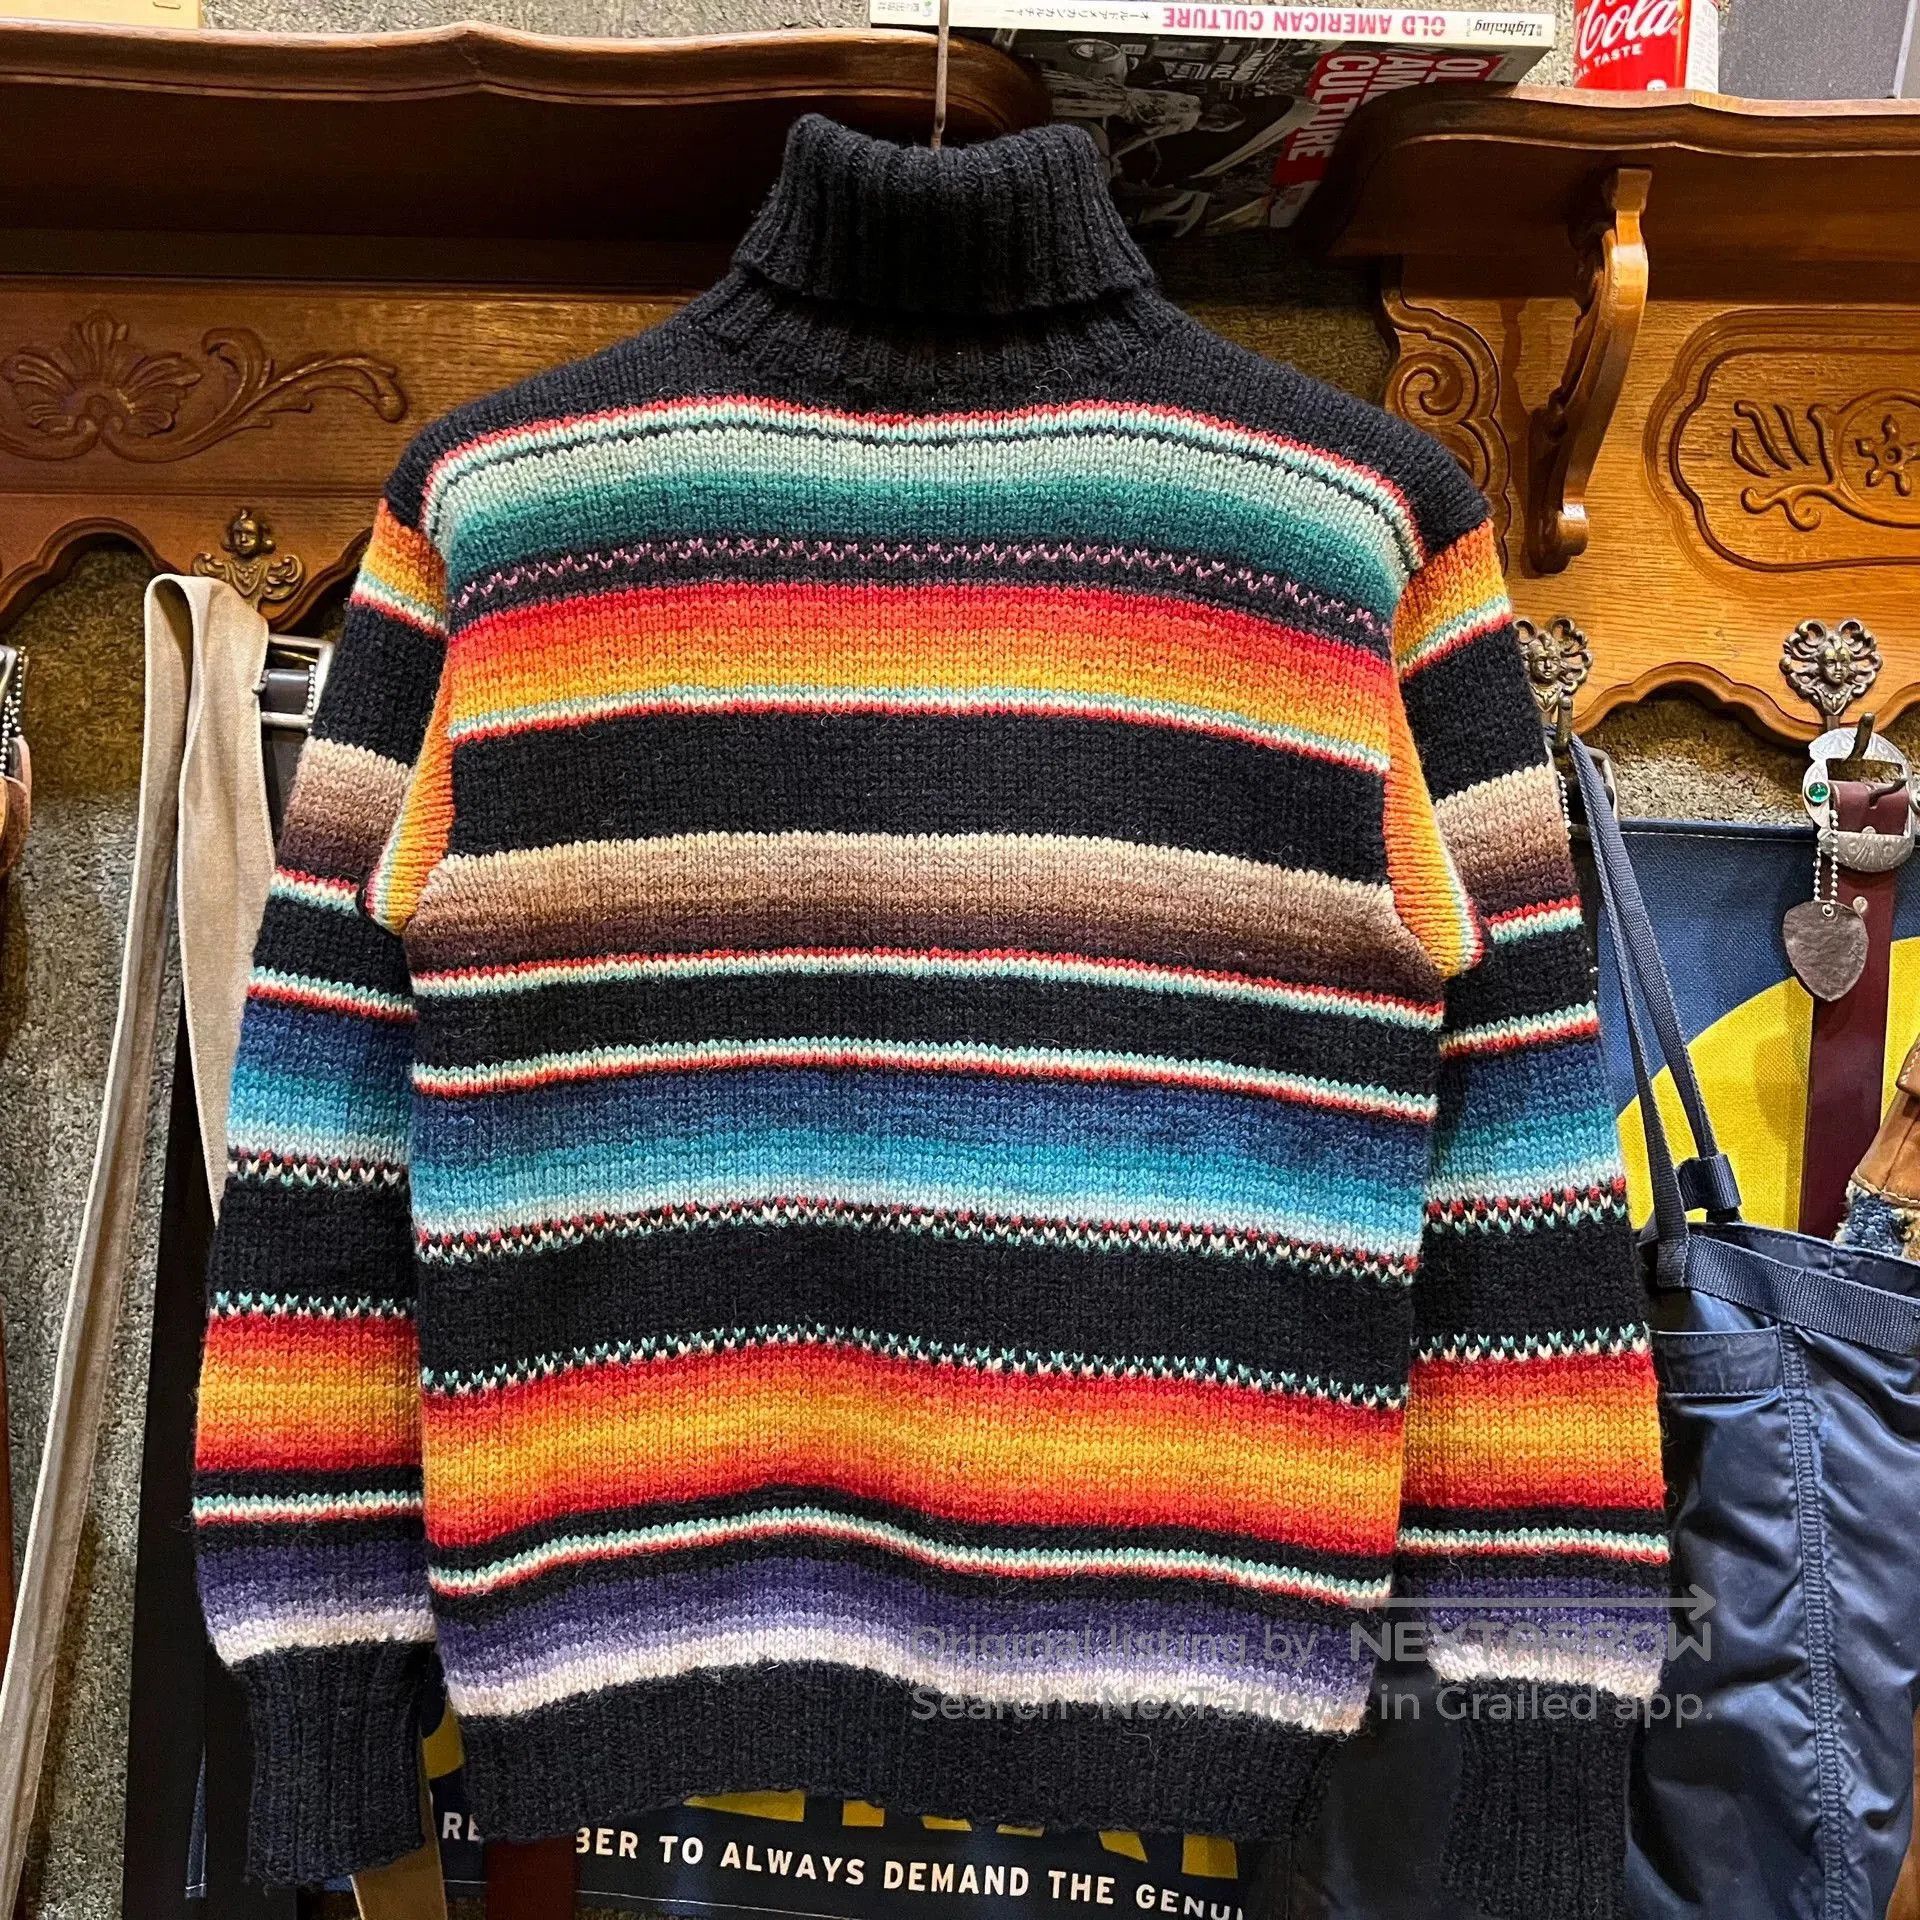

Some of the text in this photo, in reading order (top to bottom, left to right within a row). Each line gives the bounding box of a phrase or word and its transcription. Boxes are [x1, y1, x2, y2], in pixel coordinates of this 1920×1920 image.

[1162, 7, 1264, 31] CULTURE
[1273, 11, 1392, 34] AMERICAN
[1401, 16, 1446, 36] OLD
[1473, 20, 1536, 37] Lightning
[1593, 43, 1642, 67] TASTE
[1423, 57, 1490, 84] OL
[1287, 55, 1380, 162] CULTURE
[658, 1835, 704, 1865] TO
[720, 1842, 865, 1886] ALWAYS
[883, 1860, 1029, 1897] DEMAND
[1048, 1870, 1116, 1905] THE
